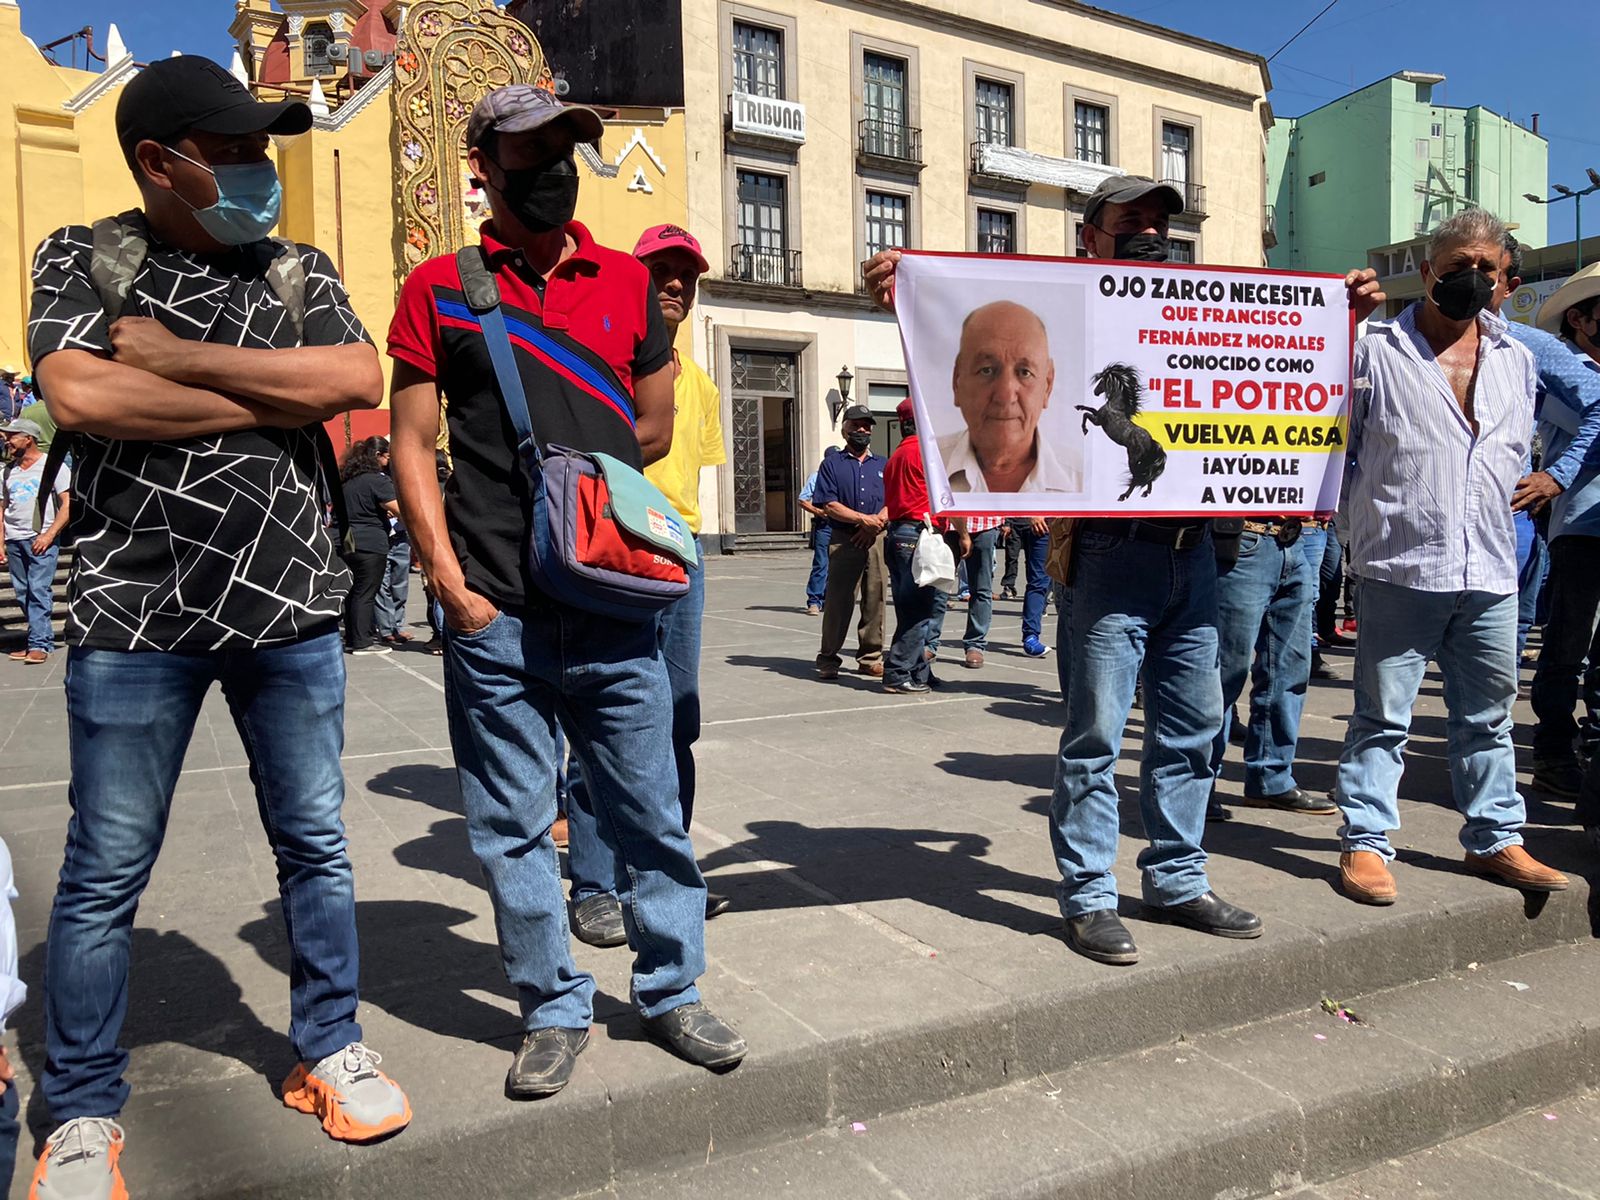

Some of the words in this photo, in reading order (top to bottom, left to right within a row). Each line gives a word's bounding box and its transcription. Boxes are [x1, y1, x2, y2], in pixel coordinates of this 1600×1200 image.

[734, 93, 802, 131] TRIBUNA
[1099, 274, 1146, 298] OJO
[1151, 277, 1225, 302] ZARCO
[1230, 282, 1325, 307] NECESITA
[1161, 305, 1198, 321] QUE
[1202, 307, 1302, 326] FRANCISCO
[1138, 327, 1243, 348] FERNÁNDEZ
[1247, 333, 1325, 352] MORALES
[1167, 354, 1260, 372] CONOCIDO
[1265, 357, 1314, 374] COMO
[1149, 378, 1202, 408] "EL
[1212, 379, 1343, 412] POTRO"
[1164, 424, 1255, 445] VUELVA
[1261, 425, 1279, 445] A
[1284, 426, 1343, 446] CASA
[1203, 453, 1299, 475] ¡AYÚDALE
[1201, 487, 1216, 504] A
[1223, 486, 1303, 505] VOLVER!
